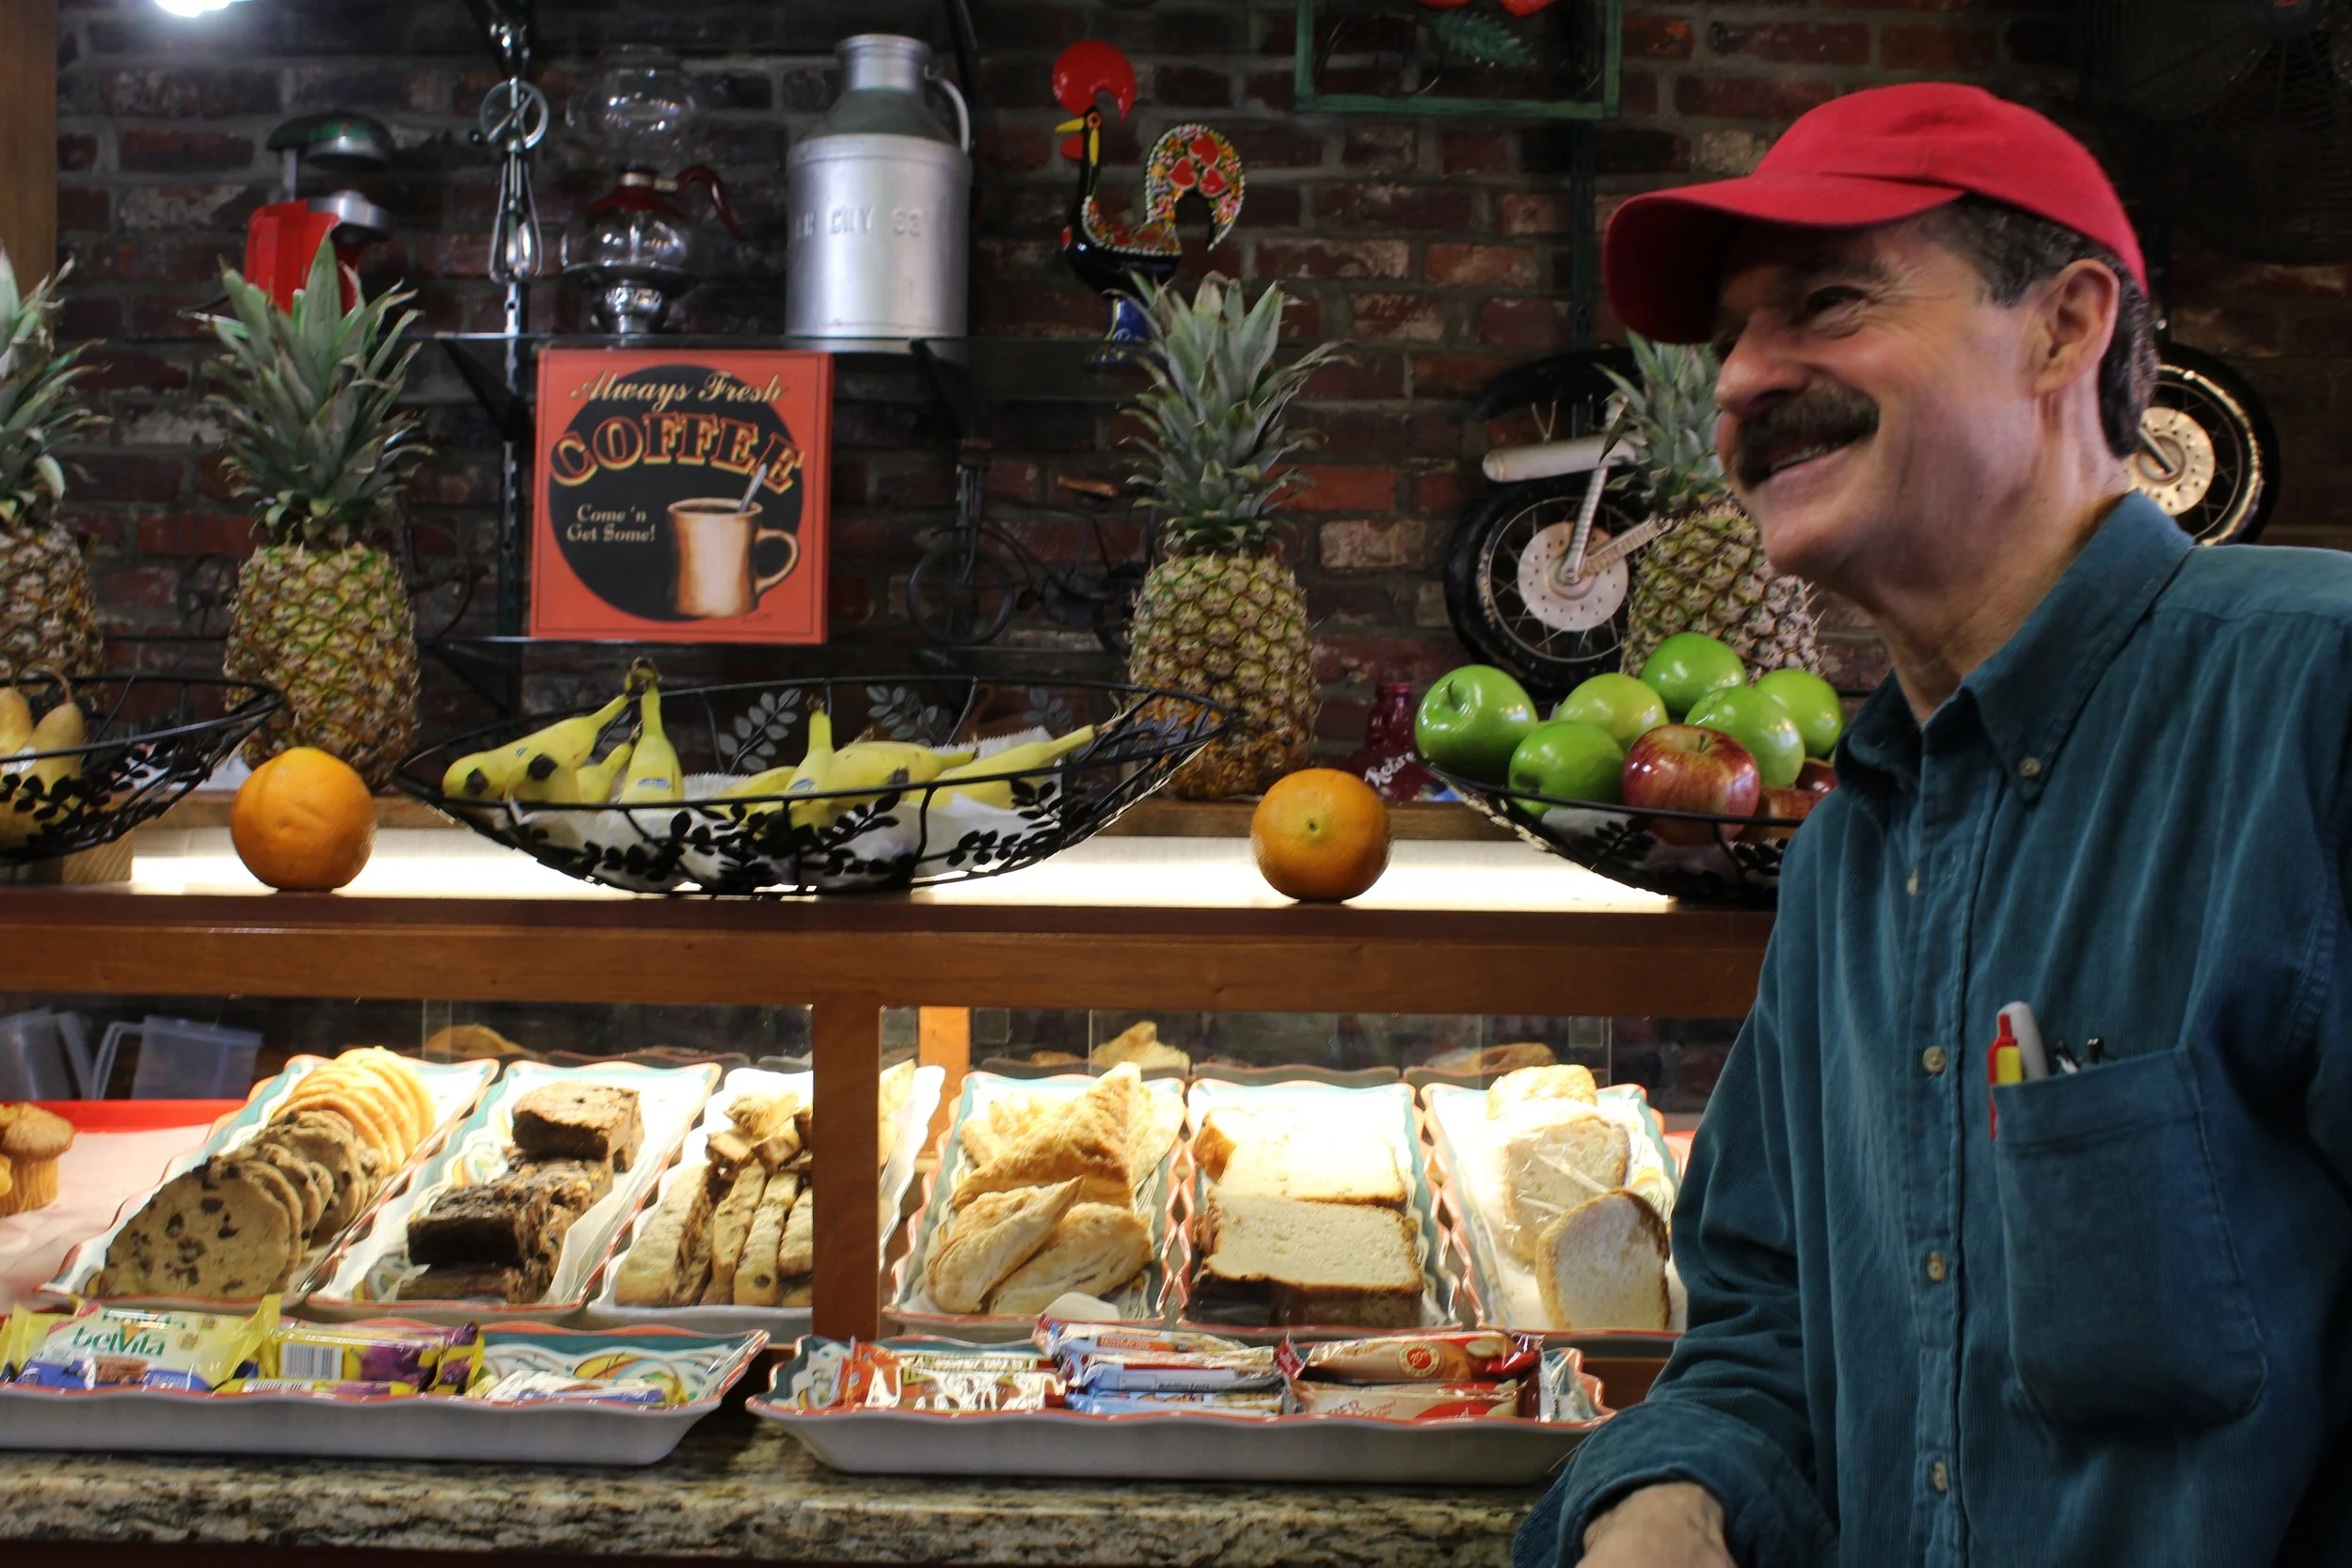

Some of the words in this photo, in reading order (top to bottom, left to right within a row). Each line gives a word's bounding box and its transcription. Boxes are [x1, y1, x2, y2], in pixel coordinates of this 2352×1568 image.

[570, 369, 692, 413] Always
[697, 371, 784, 403] Fresh
[550, 410, 805, 495] COFFEE
[576, 504, 626, 523] Come
[566, 524, 597, 543] Get
[602, 524, 656, 543] Some!
